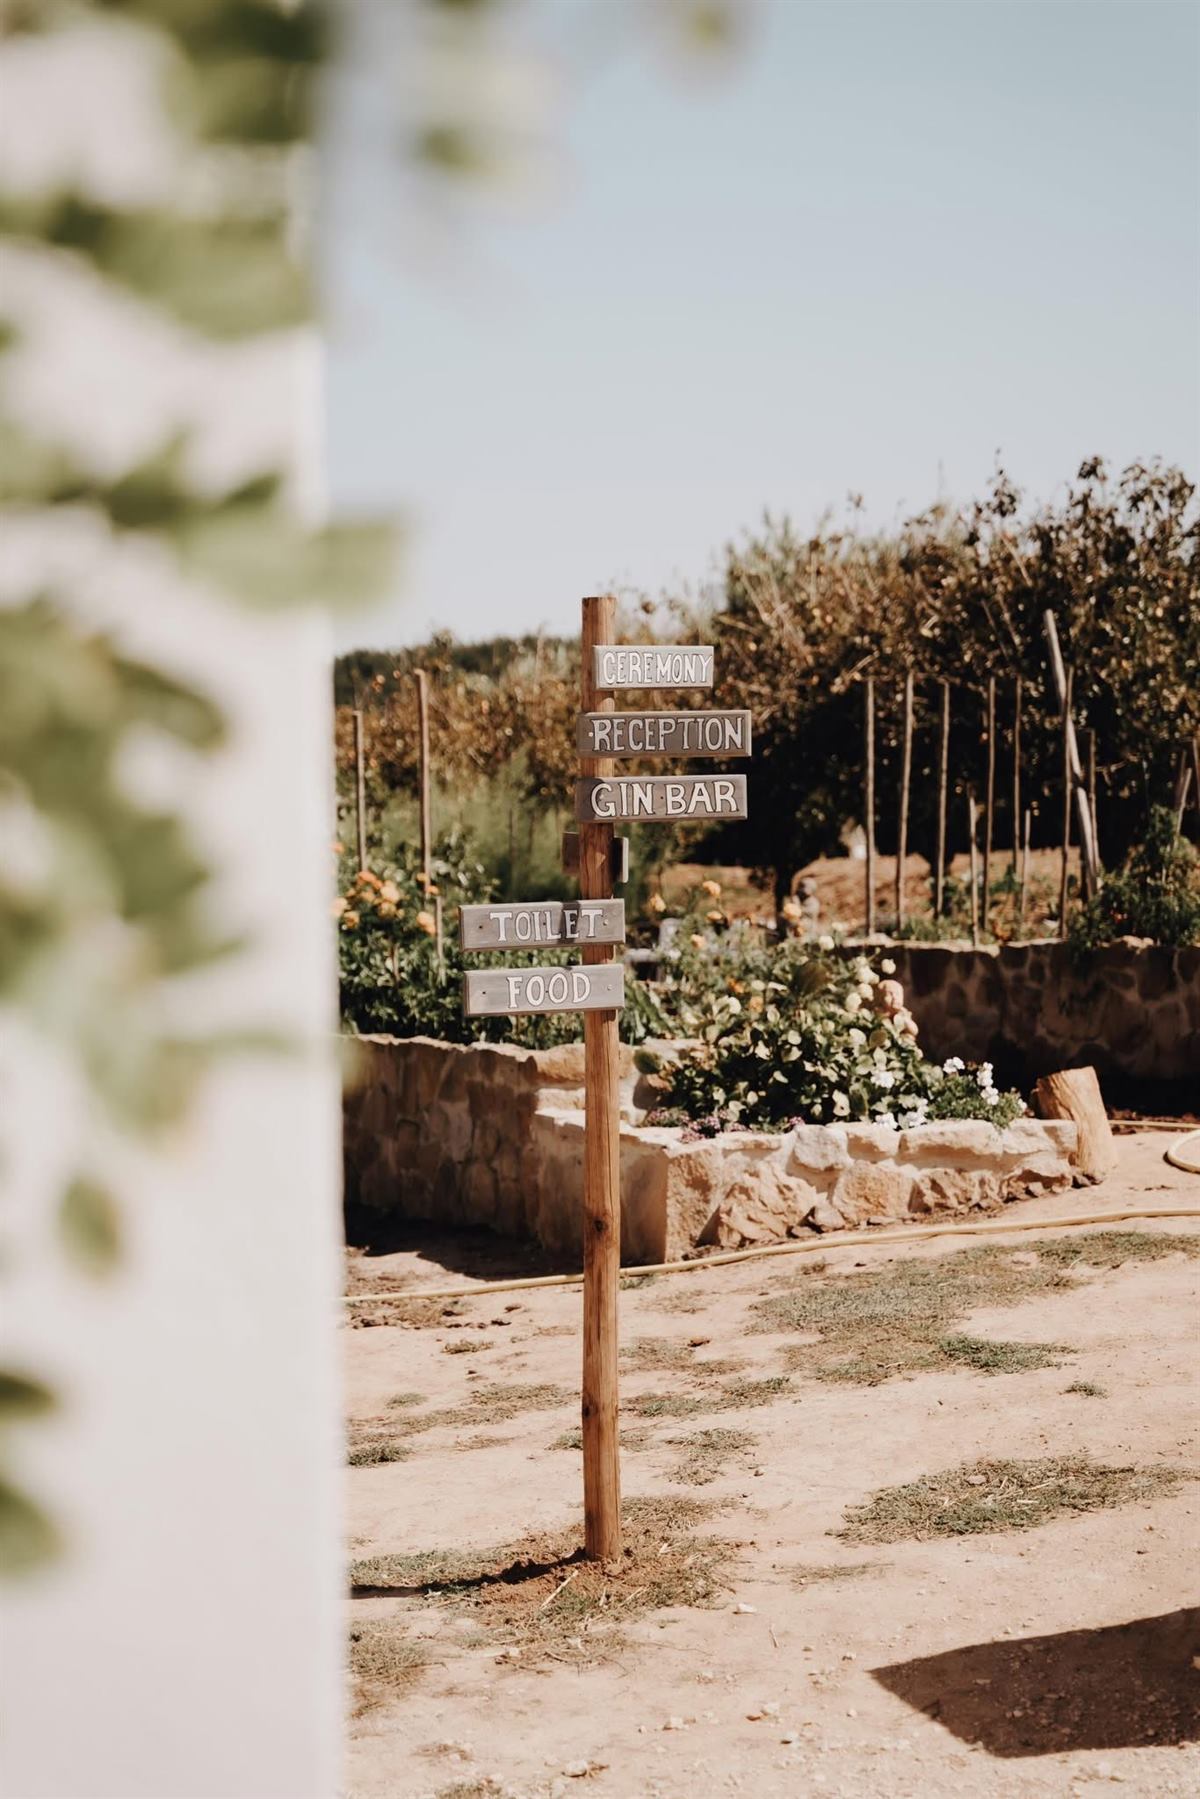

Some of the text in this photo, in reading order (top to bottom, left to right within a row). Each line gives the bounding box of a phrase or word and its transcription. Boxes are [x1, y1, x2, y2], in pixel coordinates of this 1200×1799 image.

[602, 652, 713, 685] CEREMONY
[592, 717, 743, 752] RECEPTION
[591, 781, 739, 817] GIN BAR
[490, 909, 603, 942] TOILET
[506, 972, 591, 1009] FOOD
